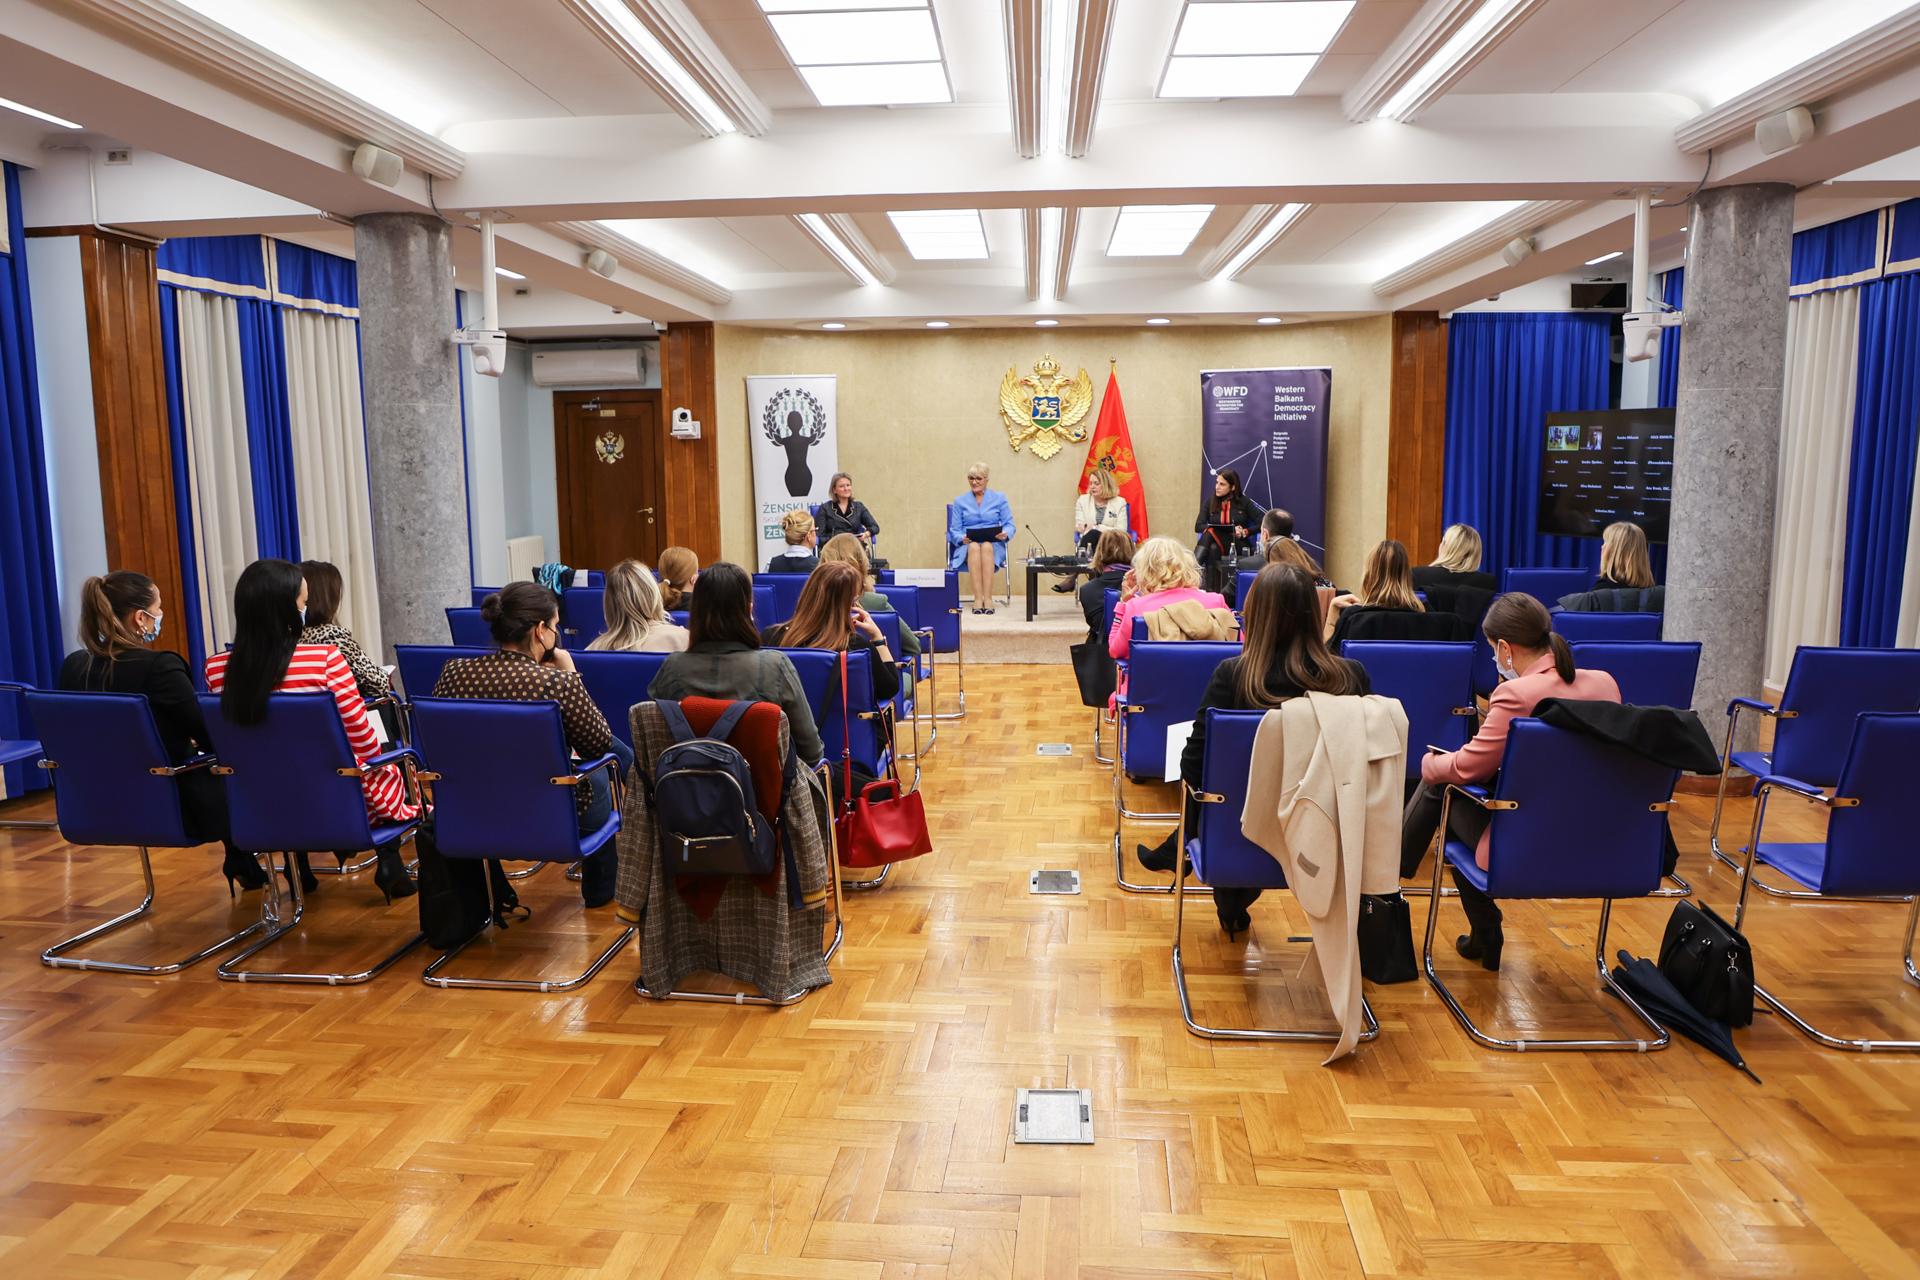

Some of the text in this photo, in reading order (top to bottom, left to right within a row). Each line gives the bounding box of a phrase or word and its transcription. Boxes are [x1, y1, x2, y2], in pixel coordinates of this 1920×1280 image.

[1223, 386, 1248, 396] WFD
[1274, 395, 1304, 403] Balkans
[1274, 404, 1316, 413] Democracy
[1274, 413, 1307, 421] Initiative
[762, 502, 803, 514] ŽENSKI
